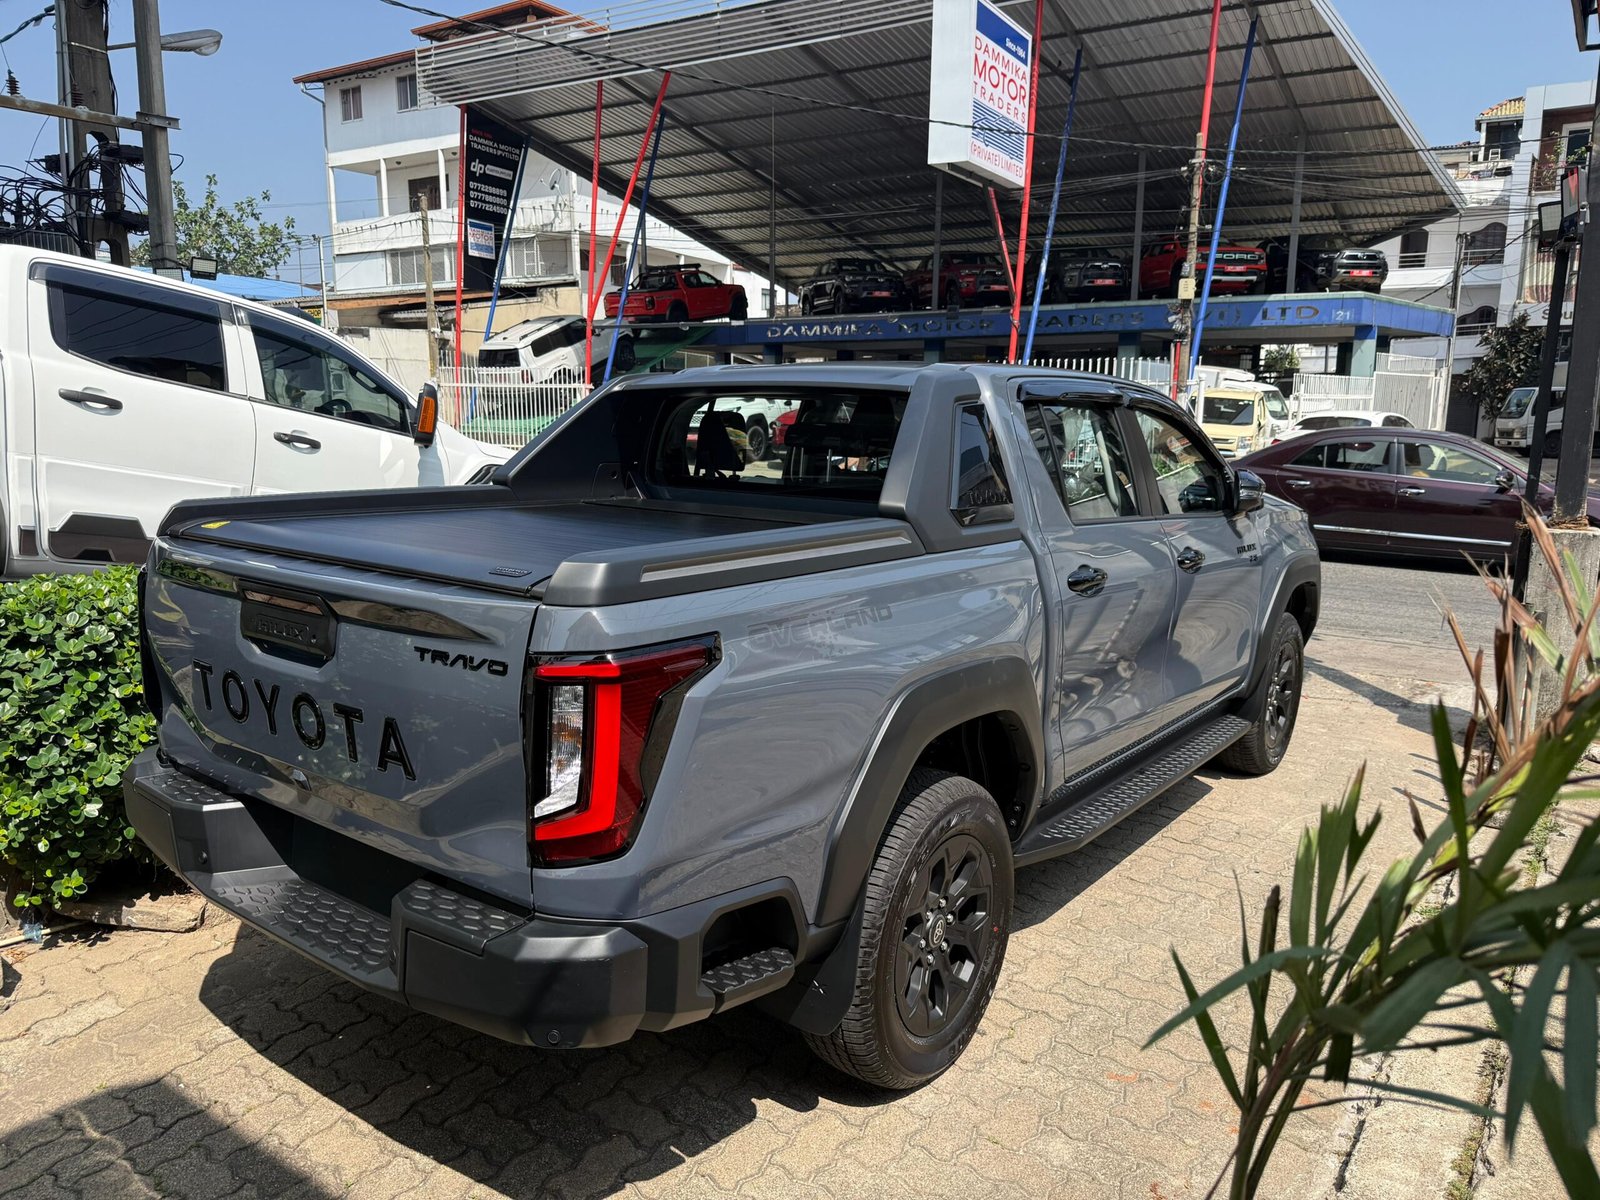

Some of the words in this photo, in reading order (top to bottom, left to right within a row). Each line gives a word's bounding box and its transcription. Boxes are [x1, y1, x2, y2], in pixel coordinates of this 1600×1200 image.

[975, 36, 1028, 85] DAMMIKA
[973, 54, 1027, 108] MOTOR
[973, 81, 1026, 124] TRADERS
[468, 134, 498, 149] DAMMIKA
[498, 143, 521, 156] MOTOR
[470, 158, 485, 177] dp
[767, 324, 883, 338] DAMMIKA
[897, 319, 995, 333] MOTOR
[1261, 306, 1320, 320] LTD
[1335, 310, 1351, 321] 21
[257, 618, 303, 641] HILUX
[413, 645, 509, 677] TRAVO
[192, 658, 417, 781] TOYOTA
